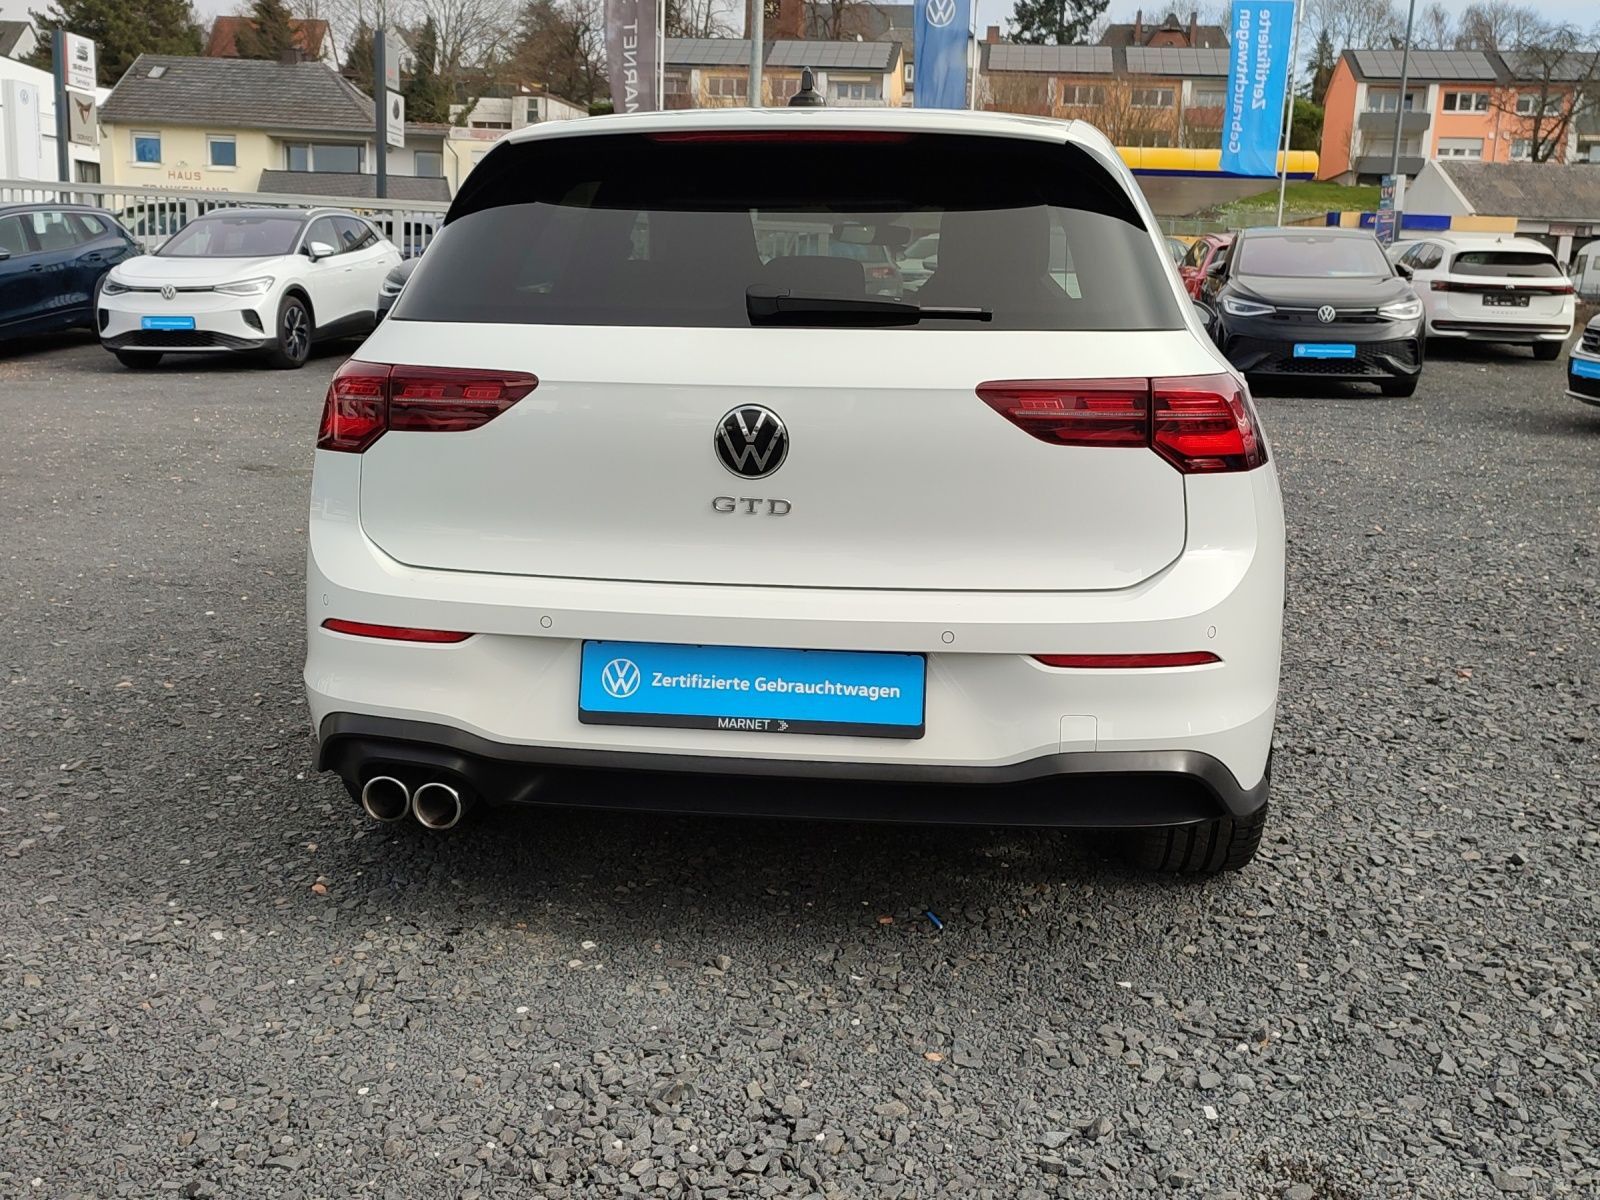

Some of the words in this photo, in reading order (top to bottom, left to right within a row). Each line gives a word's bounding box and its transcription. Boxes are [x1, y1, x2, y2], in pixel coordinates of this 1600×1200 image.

[168, 171, 201, 181] HAUS
[712, 496, 791, 515] GTD
[651, 672, 750, 691] Zertifizierte
[754, 677, 901, 700] Gebrauchtwagen
[717, 717, 770, 730] MARNET
